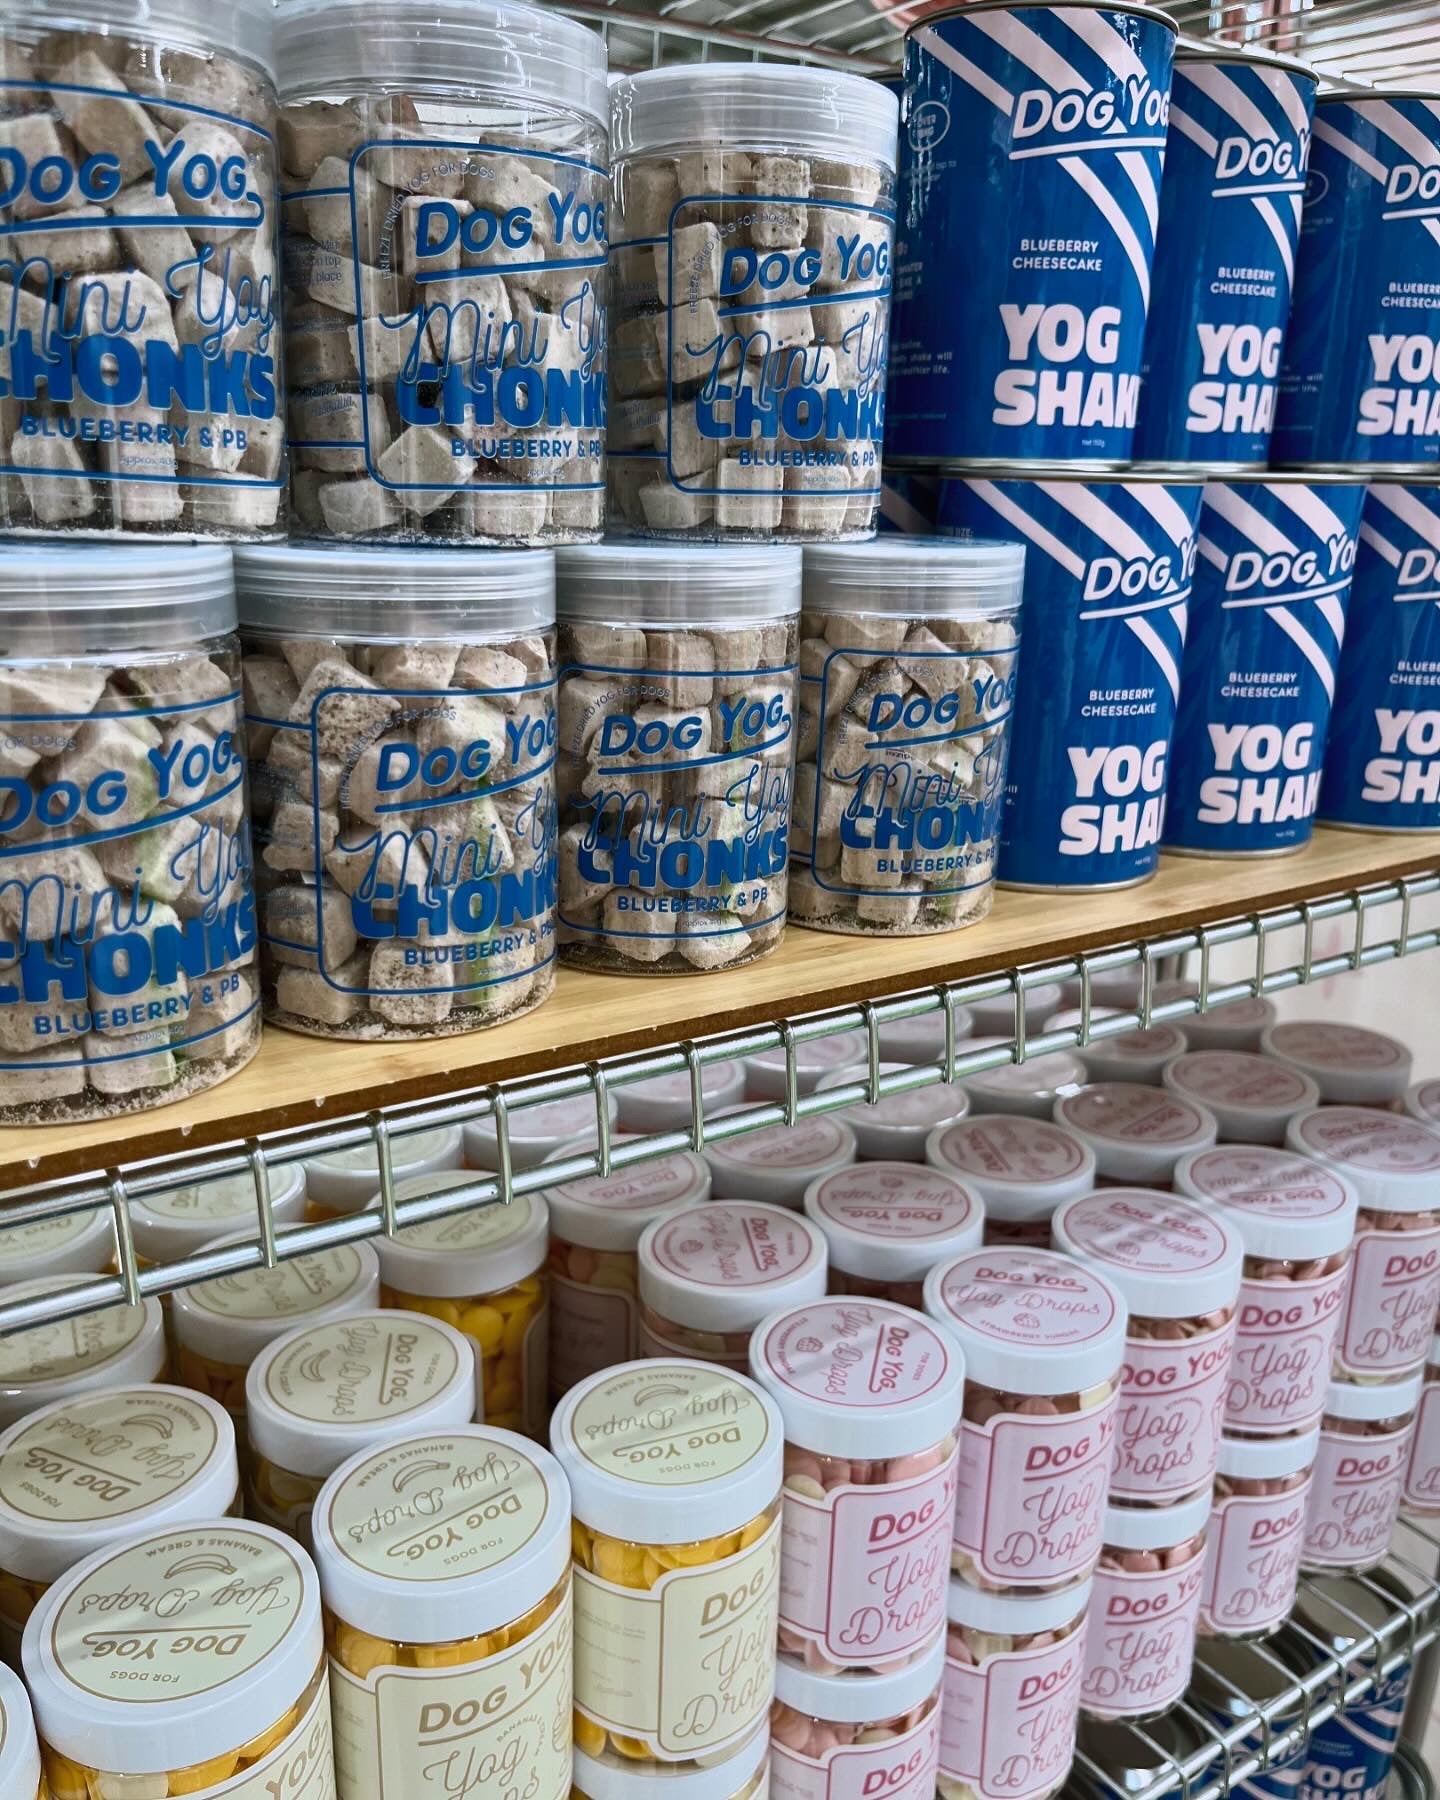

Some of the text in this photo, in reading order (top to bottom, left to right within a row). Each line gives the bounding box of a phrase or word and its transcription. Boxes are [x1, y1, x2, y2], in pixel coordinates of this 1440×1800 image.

[1013, 89, 1116, 139] DOG
[144, 140, 247, 201] YOG
[432, 163, 456, 177] FOR
[460, 162, 496, 181] DOGS
[1215, 137, 1293, 179] DOG
[1386, 164, 1440, 204] DO
[415, 201, 533, 257] DOG
[1020, 239, 1099, 254] BLUEBERRY
[719, 248, 821, 296] DOG
[836, 233, 888, 281] YOG
[1012, 257, 1103, 272] CHEESECAKE
[1218, 267, 1276, 281] BLUEBERRY
[166, 242, 276, 357] Yog
[1210, 283, 1277, 298] CHEESECAKE
[1389, 283, 1440, 295] BLUEBERR
[379, 300, 549, 393] Mini
[999, 303, 1121, 364] YOG
[1197, 324, 1282, 378] YOG
[0, 329, 277, 420] HONKS
[685, 330, 829, 410] Mini
[1368, 335, 1440, 383] YO
[992, 369, 1142, 429] SHAK
[1186, 382, 1276, 433] SHA
[21, 414, 248, 451] BLUEBERRY & PB
[452, 438, 572, 460] BLUEBERRY
[578, 439, 586, 458] &
[739, 450, 875, 468] BLUEBERRY & PB
[1084, 556, 1171, 601] DOG
[1226, 551, 1318, 592] DOG
[594, 691, 616, 708] YOG
[640, 685, 671, 698] DOGS
[1089, 687, 1154, 701] BLUEBERRY
[1220, 685, 1299, 698] CHEESECAKE
[1228, 671, 1297, 684] BLUEBERRY
[600, 693, 783, 757] DOG YOG
[868, 693, 960, 732] DOG
[1081, 703, 1156, 717] CHEESECAKE
[1207, 722, 1313, 773] YOG
[1375, 708, 1440, 756] YO
[148, 730, 233, 799] YOG
[376, 740, 491, 792] DOG
[1067, 741, 1167, 798] YOG
[570, 761, 791, 862] Mini Yog
[834, 761, 962, 829] Mini
[336, 824, 503, 908] Mini
[577, 825, 788, 889] CHONKS
[877, 855, 971, 873] BLUEBERRY
[976, 854, 983, 866] &
[617, 887, 768, 913] BLUEBERRY & PB
[404, 933, 523, 966] BLUEBERRY
[528, 930, 537, 946] &
[34, 991, 194, 1035] BLUEBERRY
[202, 986, 214, 1004] &
[220, 974, 240, 999] PB
[974, 1267, 1078, 1287] DOG YOG
[1384, 1249, 1437, 1277] DOG
[1239, 1305, 1304, 1329] DOG
[392, 1334, 418, 1398] DOG YOG
[881, 1326, 910, 1389] DOG YOG
[1188, 1345, 1229, 1380] YOG
[1236, 1341, 1310, 1384] Yog
[585, 1388, 751, 1441] Yog Drops
[1220, 1376, 1314, 1414] Drops
[629, 1427, 742, 1464] DOG YOG
[1118, 1403, 1188, 1451] Yog
[357, 1443, 454, 1488] BANANAS CREAM
[659, 1459, 716, 1474] FOR DOGS
[1025, 1437, 1090, 1471] DOG
[1337, 1455, 1391, 1477] DOG
[23, 1456, 131, 1502] DOG YOG
[348, 1451, 521, 1544] Yog Drops
[406, 1494, 523, 1561] DOG YOG
[869, 1499, 934, 1543] DOG
[1023, 1482, 1095, 1535] Yog
[1251, 1508, 1298, 1540] DOG
[146, 1537, 263, 1557] BANANAS CREAM
[443, 1537, 504, 1566] FOR DOGS
[78, 1576, 290, 1619] Yog Drops
[701, 1568, 764, 1625] DOG
[867, 1544, 940, 1608] Yog
[1106, 1595, 1169, 1619] DOG
[93, 1634, 246, 1661] DOG YOG
[1105, 1630, 1174, 1672] Yog
[110, 1669, 181, 1683] FOR DOGS
[1019, 1658, 1072, 1701] DOG
[1081, 1656, 1180, 1699] Drops
[418, 1685, 507, 1734] DOG
[423, 1735, 528, 1800] Yog
[862, 1750, 922, 1796] DOG
